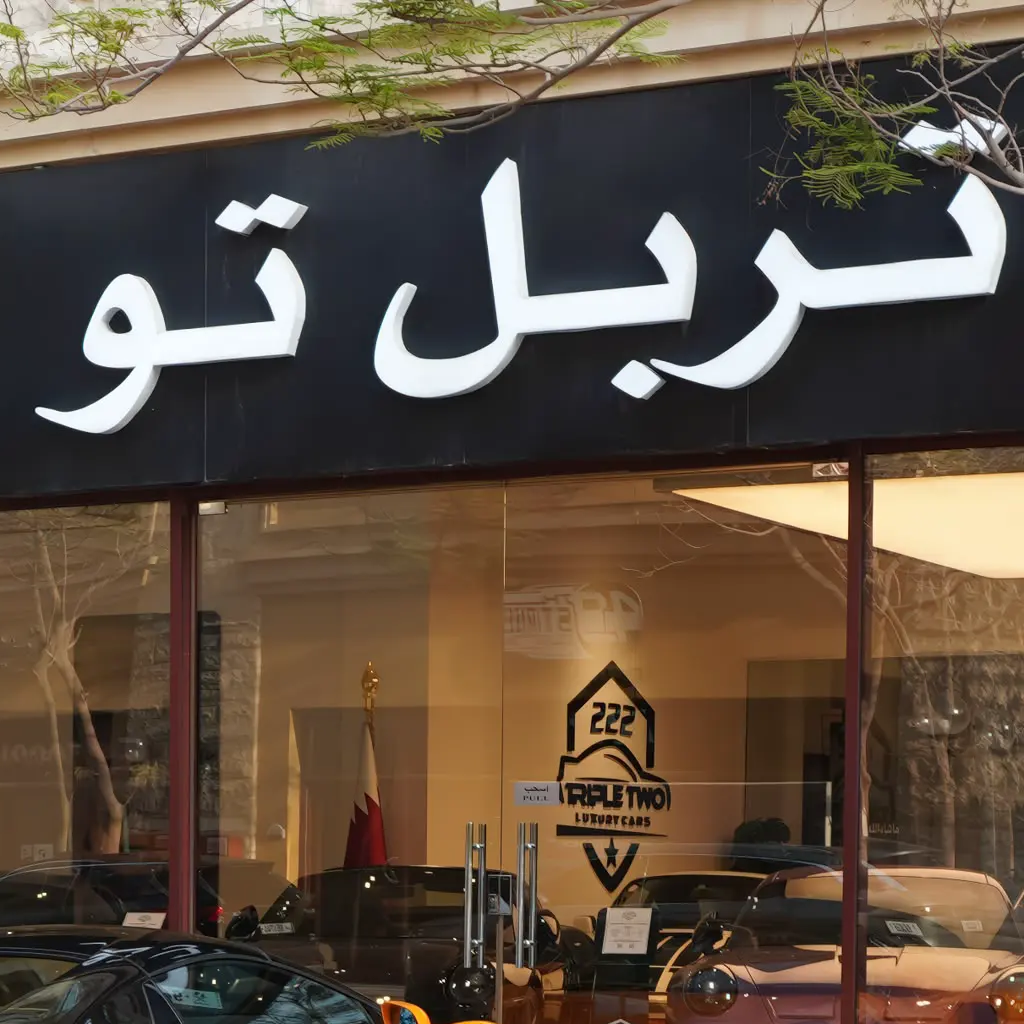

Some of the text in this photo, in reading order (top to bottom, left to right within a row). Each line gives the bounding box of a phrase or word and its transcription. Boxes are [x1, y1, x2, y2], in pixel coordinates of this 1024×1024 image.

[35, 113, 1008, 435] تربل تو
[589, 701, 636, 738] 222
[565, 782, 666, 811] TRIPLE TWO
[575, 812, 651, 828] LUXURY CARS
